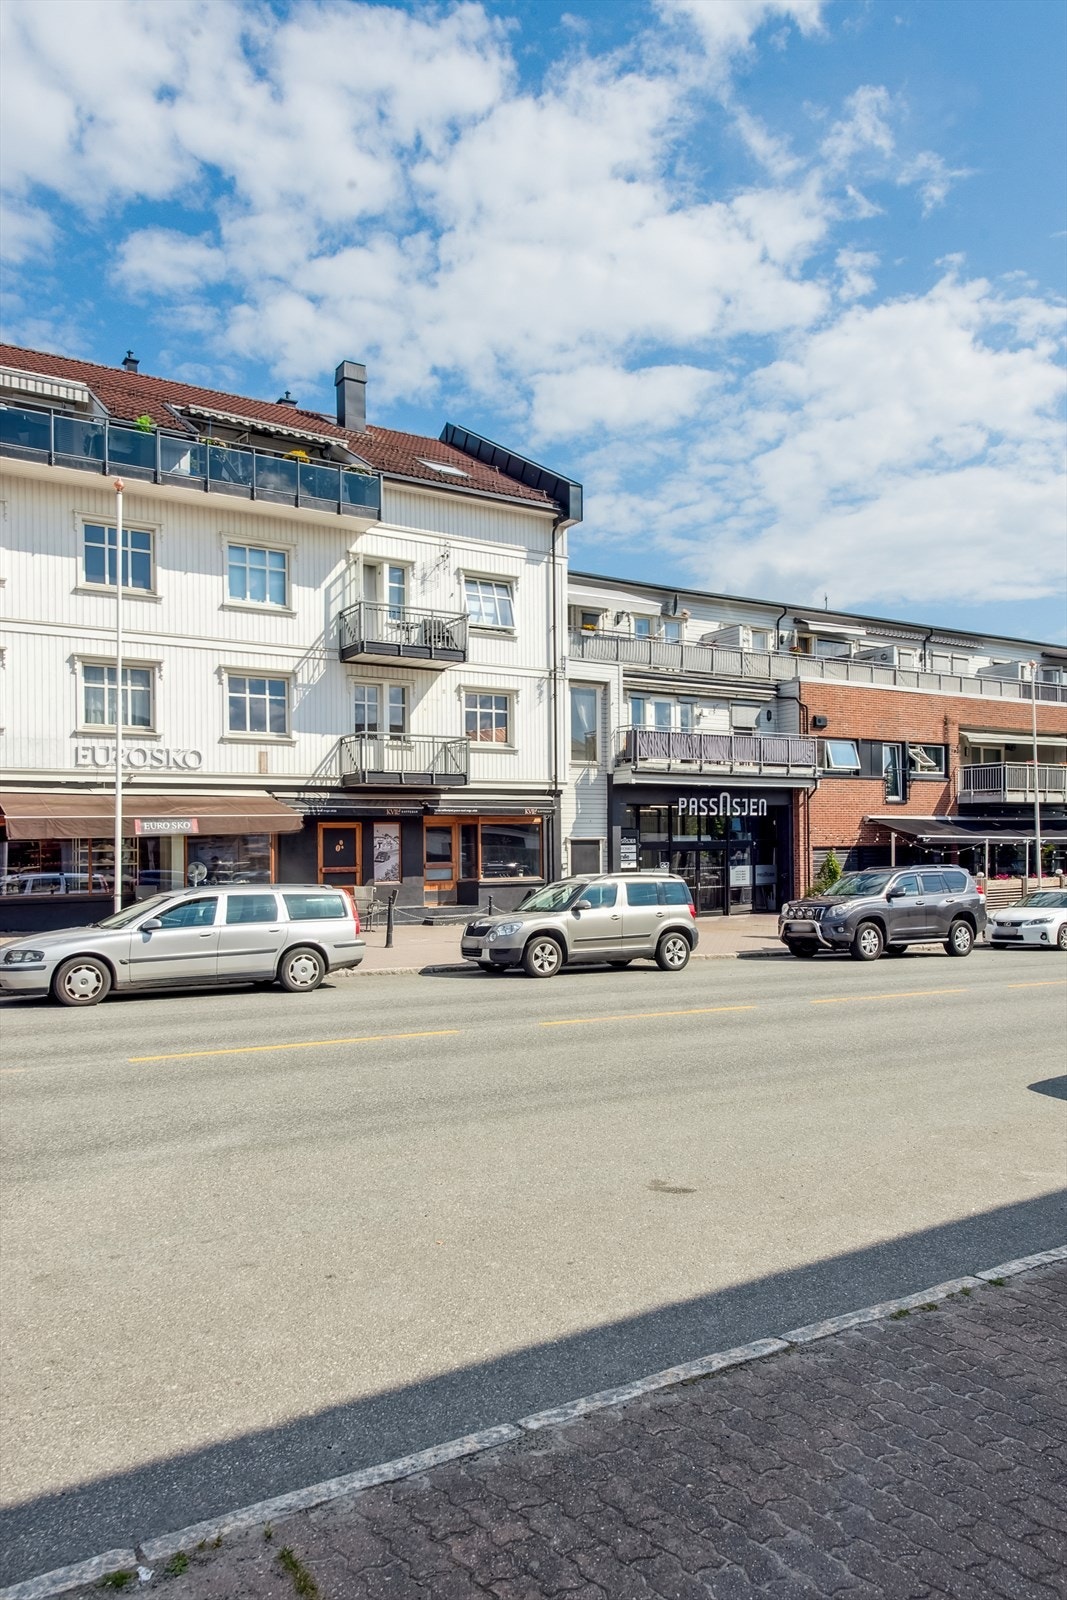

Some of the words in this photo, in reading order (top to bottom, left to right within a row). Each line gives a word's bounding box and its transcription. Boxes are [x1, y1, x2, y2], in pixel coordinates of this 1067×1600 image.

[75, 746, 202, 770] EUROSKO
[144, 821, 170, 831] EURO
[171, 821, 191, 831] SKO
